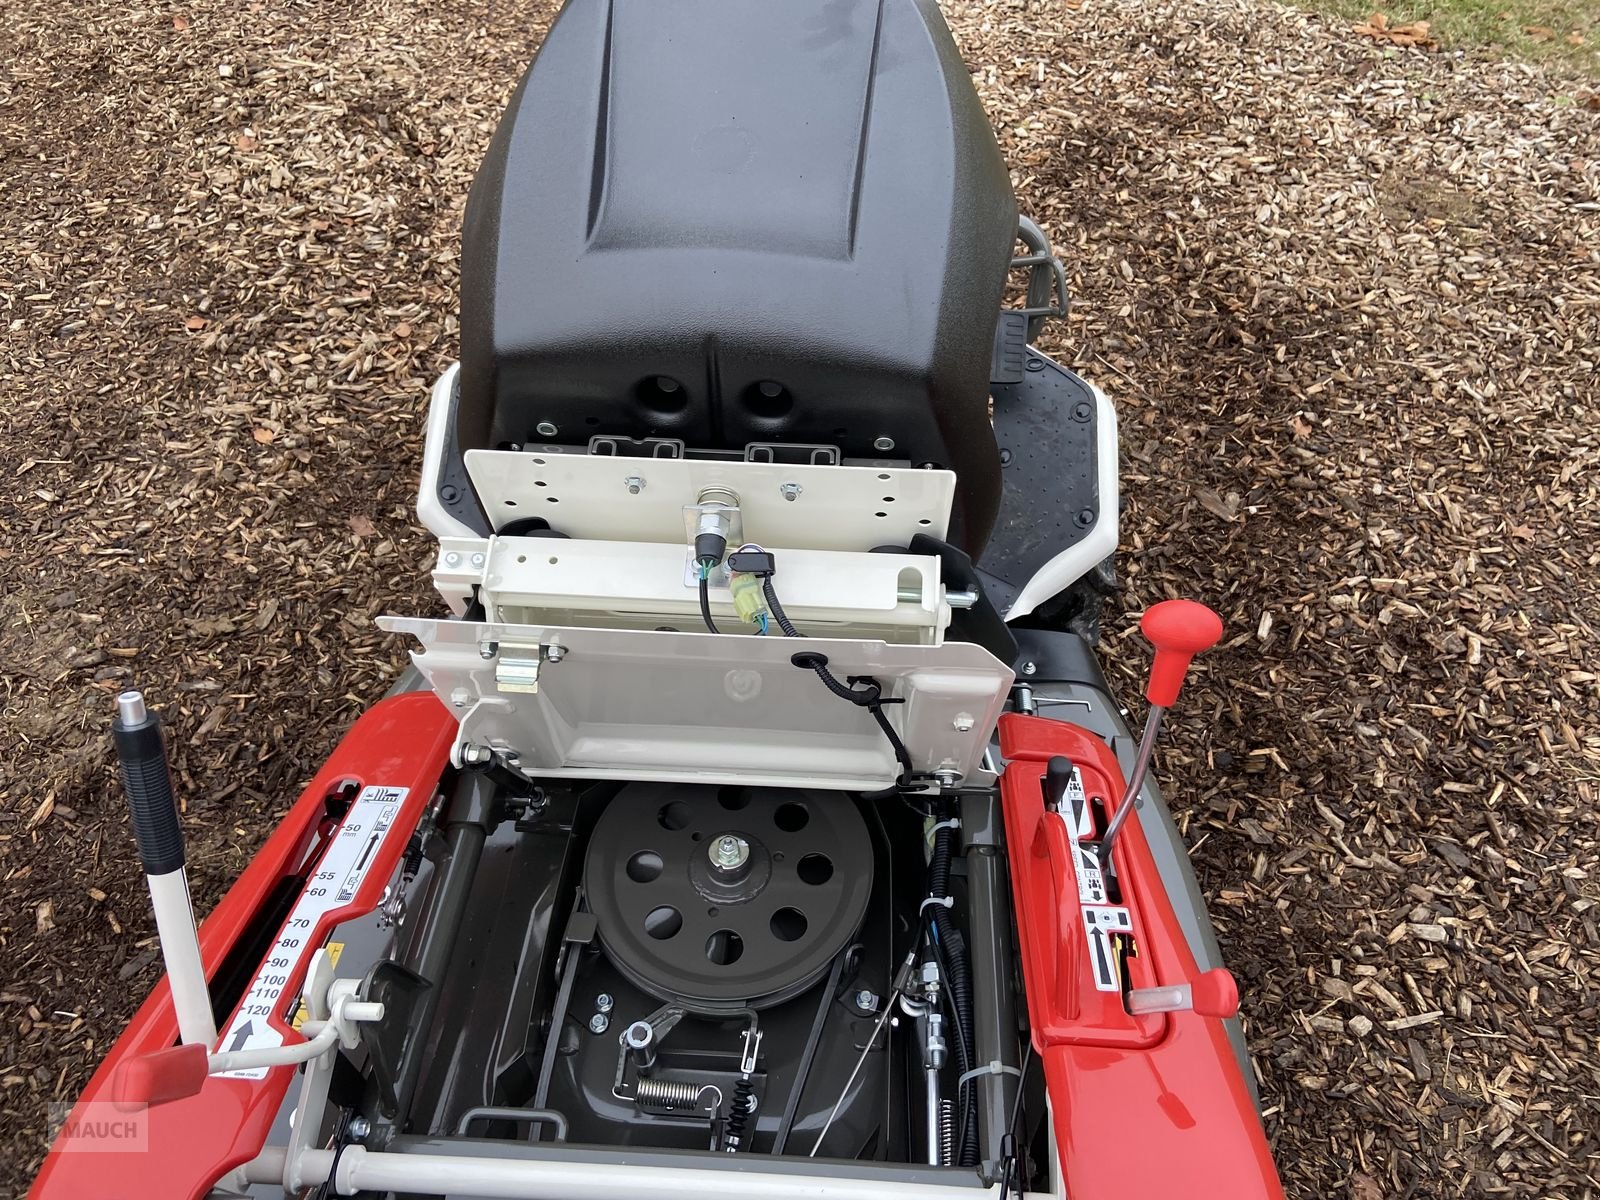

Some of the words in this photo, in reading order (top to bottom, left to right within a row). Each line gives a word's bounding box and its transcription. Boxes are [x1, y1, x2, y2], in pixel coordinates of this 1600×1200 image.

[345, 824, 361, 832] 50
[318, 871, 336, 880] 55
[310, 888, 326, 896] 60
[292, 919, 310, 928] 70
[281, 938, 299, 948] 80
[270, 958, 289, 968] 90
[263, 974, 286, 985] 100
[256, 988, 279, 999] 110
[246, 1005, 271, 1016] 120
